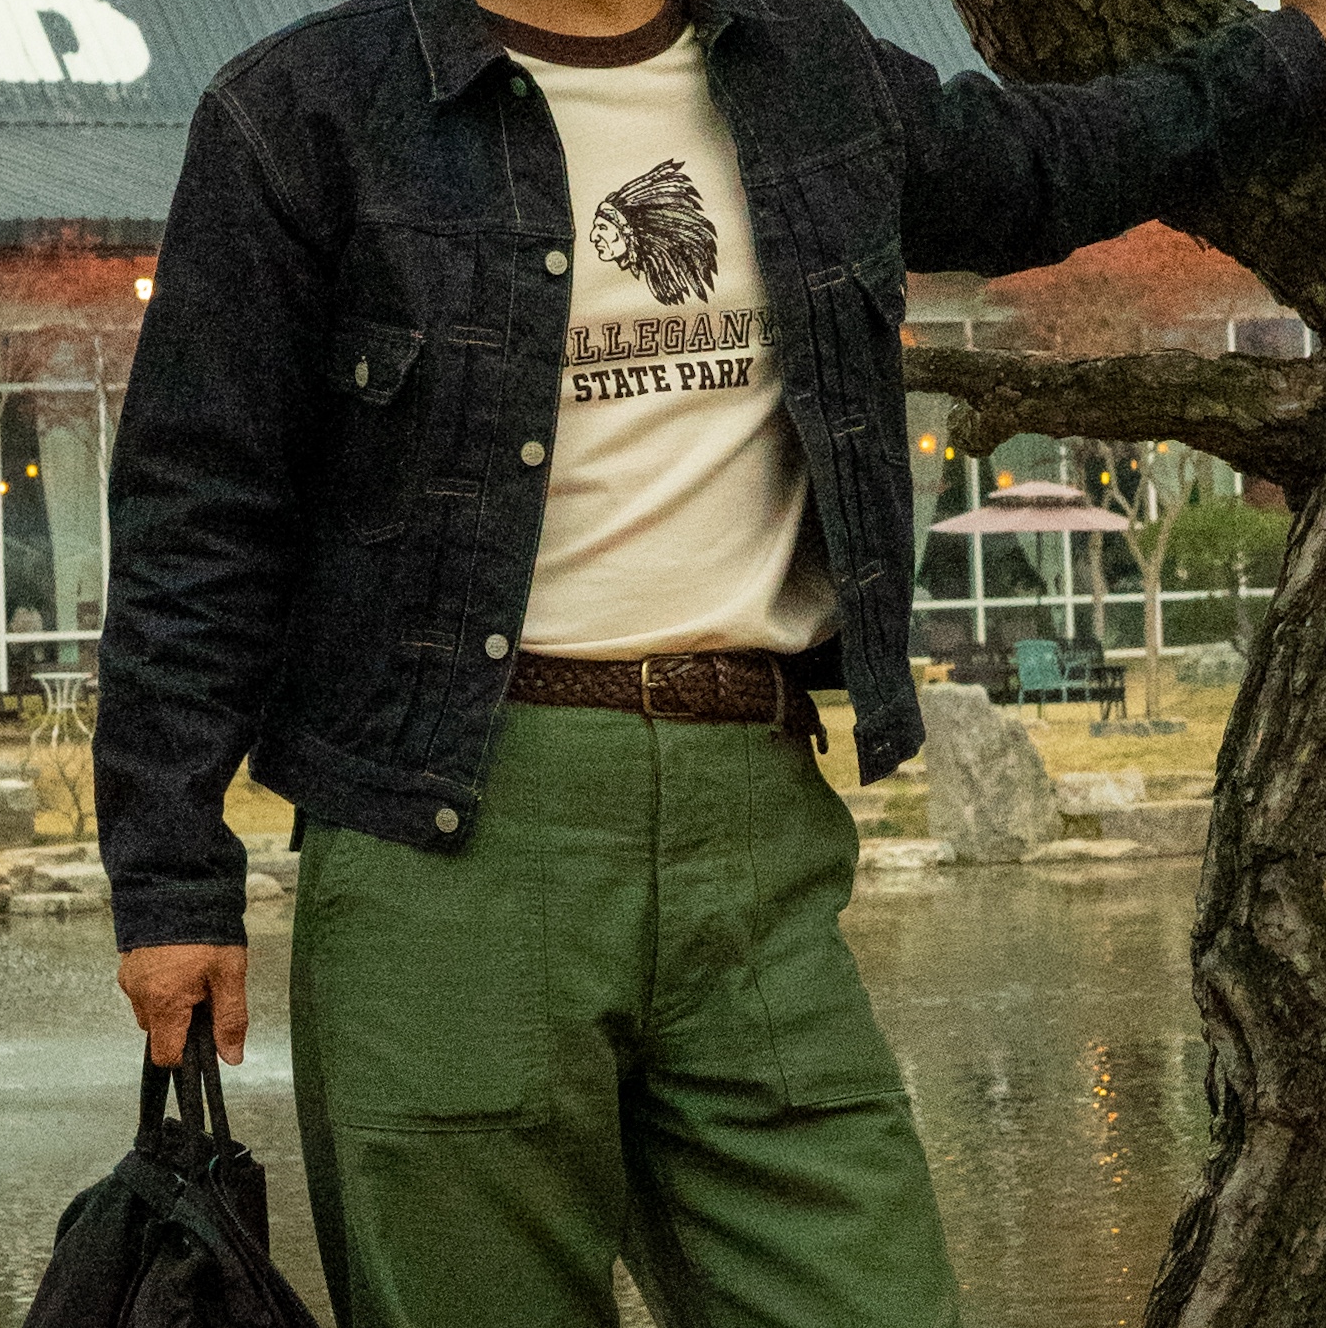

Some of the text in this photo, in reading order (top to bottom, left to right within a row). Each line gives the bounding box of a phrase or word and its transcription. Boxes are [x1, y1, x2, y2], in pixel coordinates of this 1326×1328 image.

[562, 308, 775, 368] LLEGANY
[572, 357, 755, 403] STATE PARK
